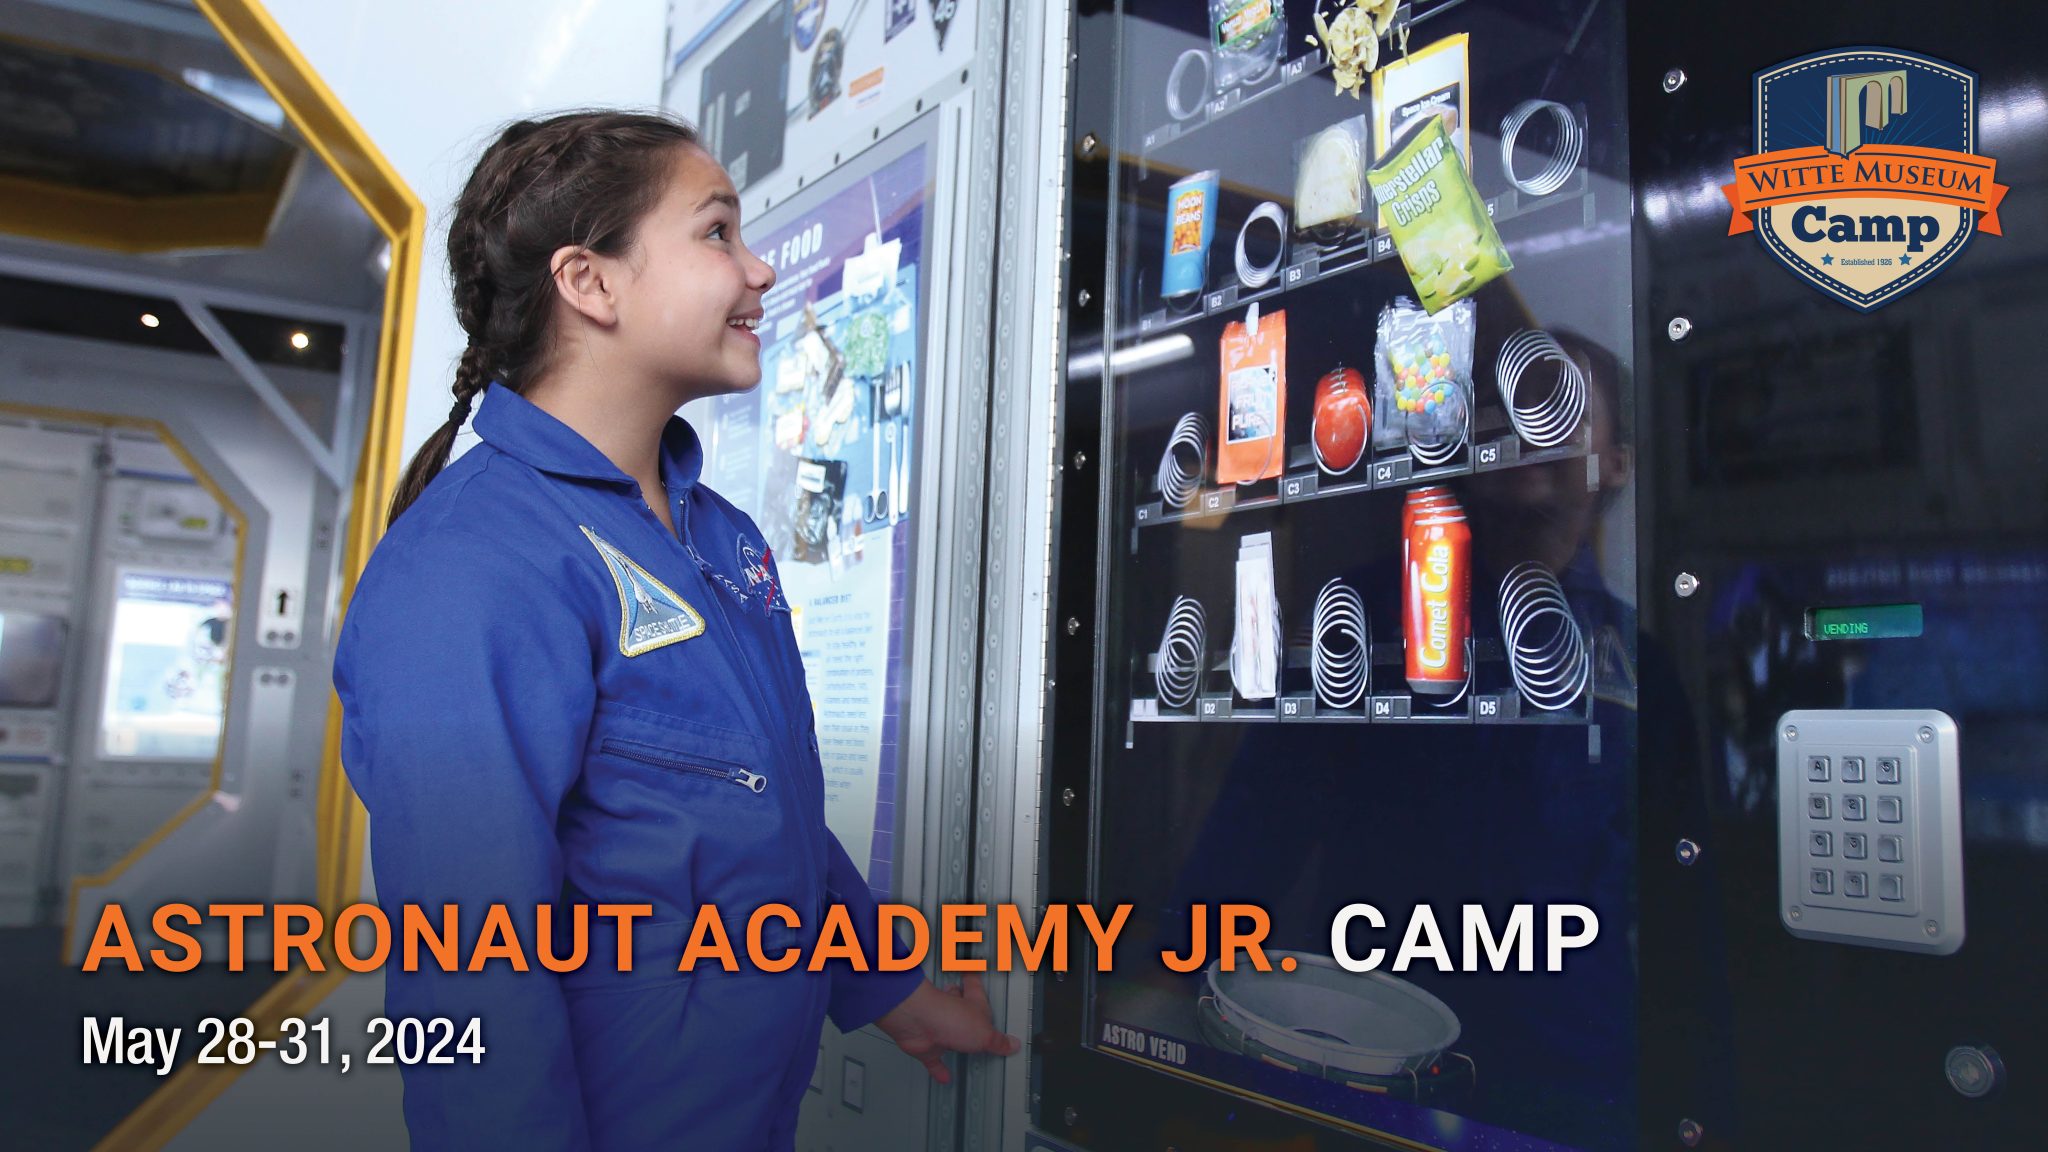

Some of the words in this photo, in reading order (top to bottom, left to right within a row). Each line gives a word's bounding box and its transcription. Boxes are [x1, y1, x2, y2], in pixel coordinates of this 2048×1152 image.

[1291, 62, 1303, 76] A3
[1391, 179, 1442, 226] Crisps
[780, 222, 823, 270] FOOD
[1378, 238, 1391, 252] B4
[1289, 269, 1302, 283] B3
[1211, 295, 1223, 308] B2
[1480, 447, 1496, 463] C5
[1377, 466, 1391, 480] C4
[1287, 483, 1300, 495] C3
[1208, 497, 1219, 508] C2
[1138, 509, 1148, 520] C1
[1421, 545, 1450, 593] Cola
[1419, 598, 1447, 668] Comet
[1824, 623, 1869, 635] VENDING
[1204, 702, 1216, 715] D2
[1284, 702, 1297, 715] D3
[1375, 701, 1390, 715] D4
[1480, 701, 1496, 715] D5
[1103, 1023, 1145, 1053] ASTRO
[1149, 1035, 1187, 1065] VEND
